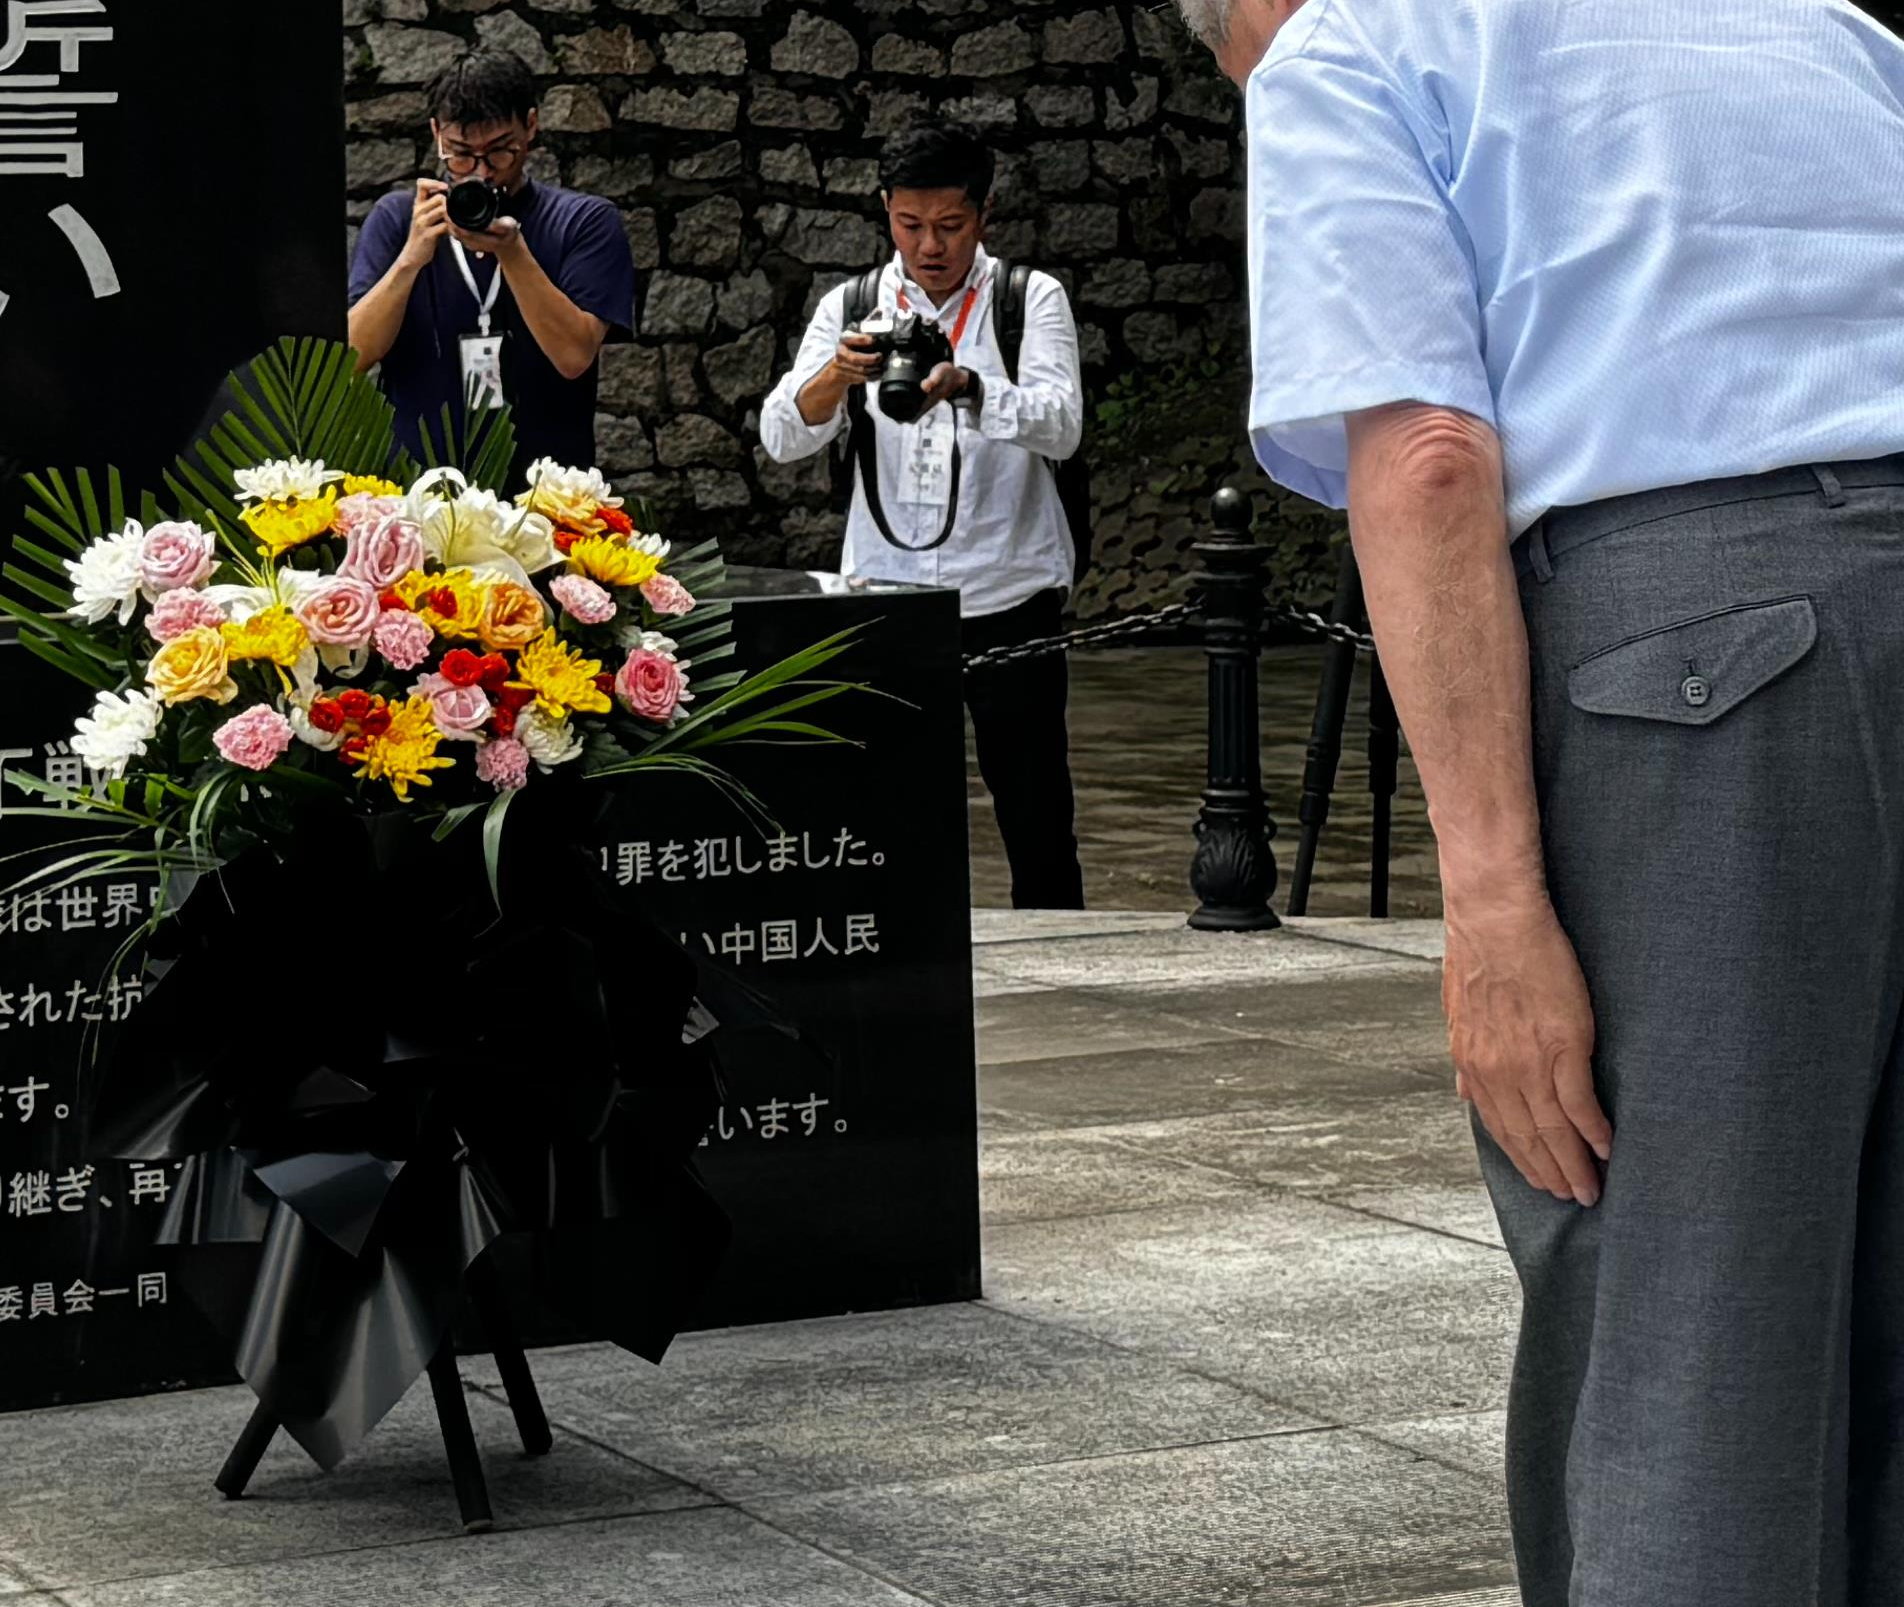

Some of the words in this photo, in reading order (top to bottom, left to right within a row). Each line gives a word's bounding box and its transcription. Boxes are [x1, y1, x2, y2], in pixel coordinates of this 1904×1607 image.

[600, 827, 885, 886] 罪を犯しました。
[698, 1092, 847, 1146] います。
